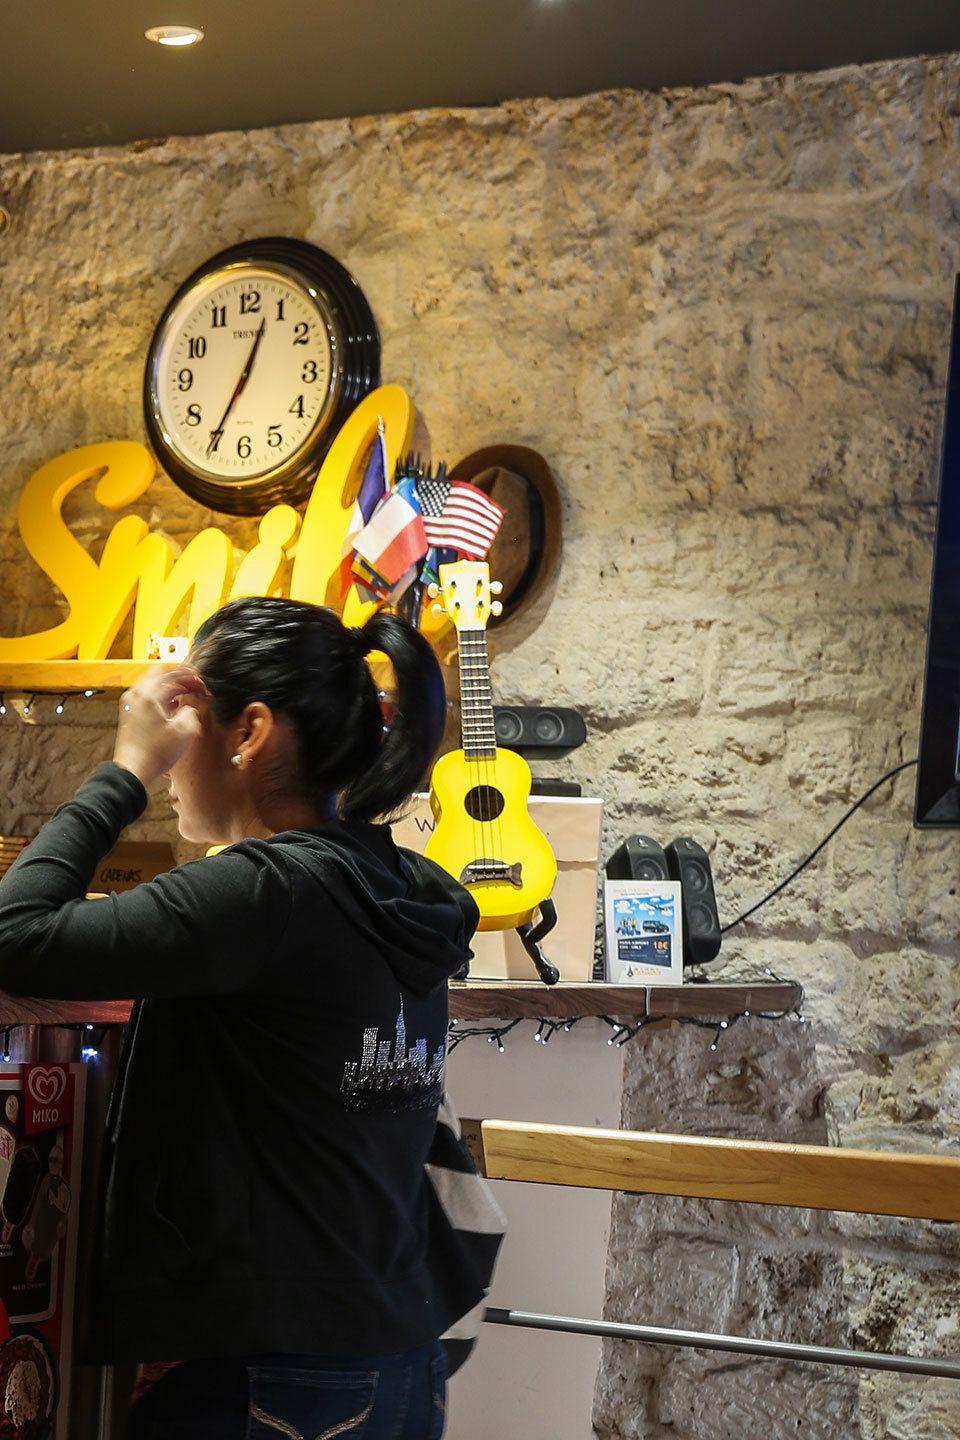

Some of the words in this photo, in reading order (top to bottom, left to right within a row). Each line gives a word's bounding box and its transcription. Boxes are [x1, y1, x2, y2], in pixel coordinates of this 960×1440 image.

[240, 291, 260, 314] 12
[276, 299, 285, 321] 1
[211, 306, 227, 328] 11
[293, 322, 309, 345] 2
[188, 337, 207, 359] 10
[178, 368, 193, 391] 9
[302, 361, 318, 383] 3
[185, 404, 201, 426] 8
[289, 395, 305, 418] 4
[210, 429, 223, 452] 7
[237, 436, 251, 458] 6
[267, 425, 282, 447] 5
[32, 1109, 59, 1123] MIKO
